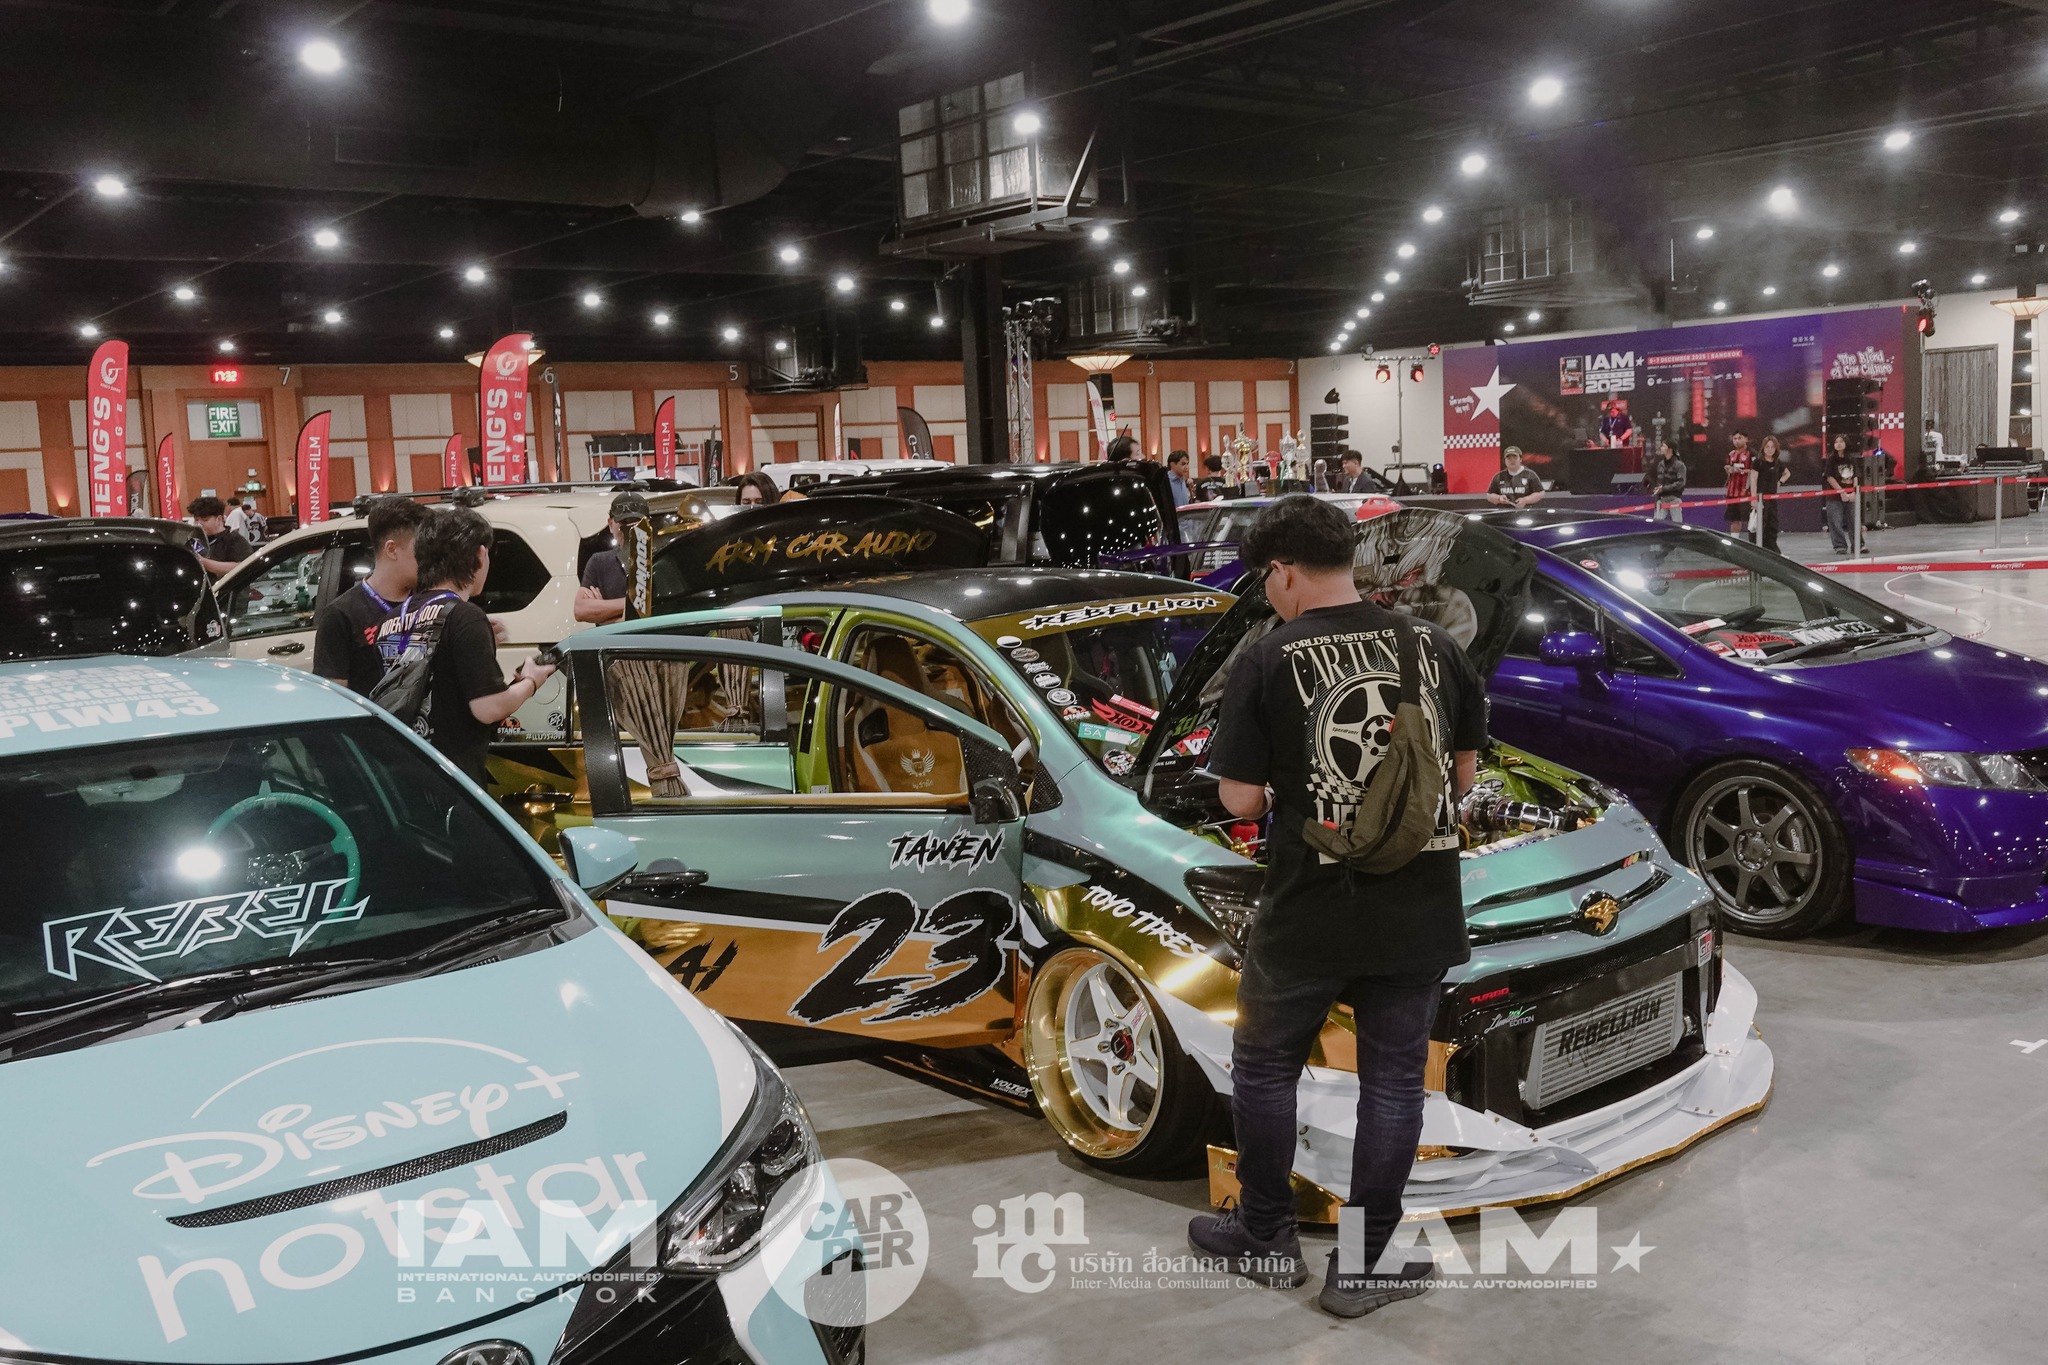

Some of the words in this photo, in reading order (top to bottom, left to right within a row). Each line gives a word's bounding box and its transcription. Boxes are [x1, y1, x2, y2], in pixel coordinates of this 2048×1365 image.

[278, 366, 291, 386] 7
[729, 364, 739, 381] 5
[1585, 351, 1634, 371] IAM
[1585, 379, 1635, 394] 2025
[208, 407, 238, 420] FIRE
[209, 420, 238, 433] EXIT
[114, 403, 123, 505] ARAGE
[309, 436, 321, 471] FILM
[486, 388, 508, 485] ENG'S
[512, 391, 523, 483] ARAGE
[706, 534, 777, 574] ARM
[785, 530, 850, 563] CAR
[852, 528, 927, 559] AUDIO
[1019, 596, 1222, 631] REBELLION
[1281, 634, 1332, 654] WORLD'S
[1332, 629, 1380, 644] FASTEST
[887, 828, 1003, 875] TAWEN
[43, 878, 371, 983] REBEL
[1080, 884, 1136, 918] TOYO
[1128, 910, 1208, 958] TIRES
[787, 887, 1017, 1026] 23
[1509, 1015, 1535, 1027] EDITION
[1558, 997, 1662, 1058] REBELLION
[993, 1077, 1033, 1095] VOLTEX
